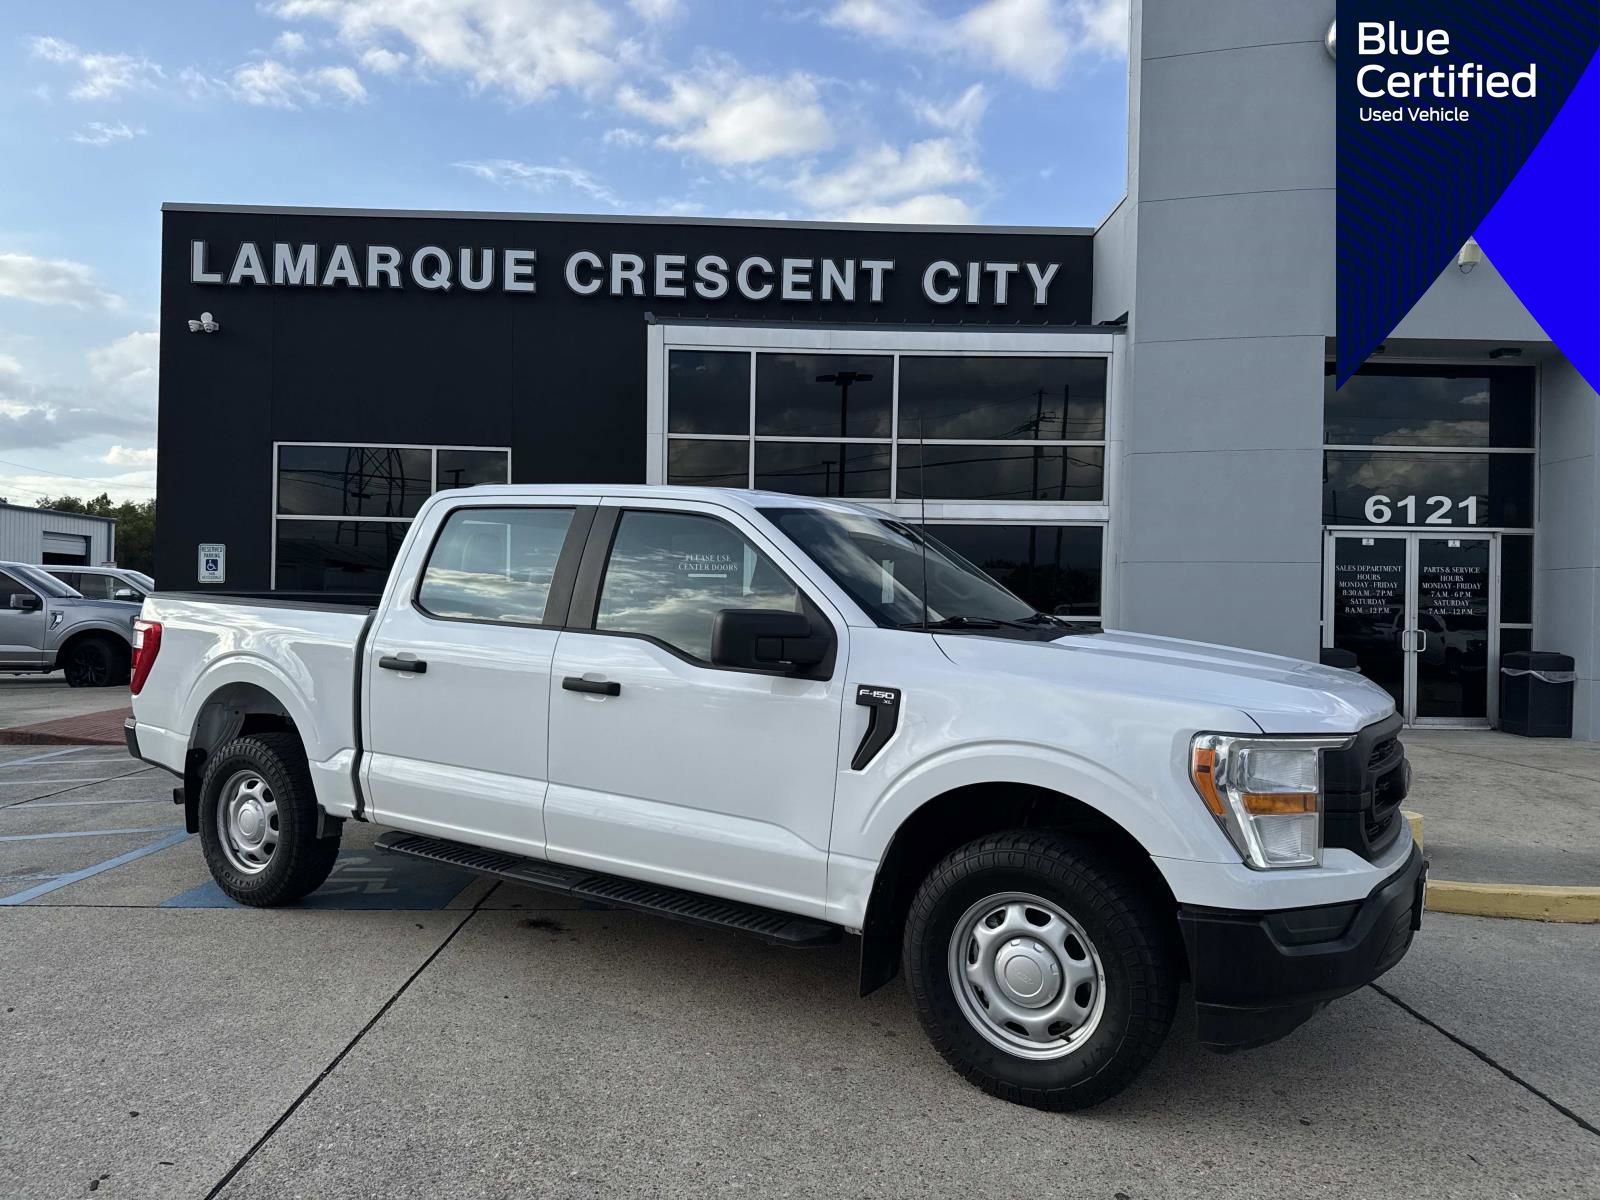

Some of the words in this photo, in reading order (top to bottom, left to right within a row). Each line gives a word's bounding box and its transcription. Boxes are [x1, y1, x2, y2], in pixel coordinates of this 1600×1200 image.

[191, 239, 537, 293] LAMARQUE
[564, 250, 896, 302] CRESCENT
[921, 259, 1062, 305] CITY
[1364, 494, 1477, 524] 6121
[678, 563, 710, 571] CENTER
[711, 564, 738, 572] DOORS
[1357, 565, 1402, 573] DEPARTMENT
[1356, 573, 1381, 581] HOURS
[1373, 581, 1399, 589] FRIDAY
[1422, 582, 1452, 590] MONDAY
[859, 689, 895, 700] F-150
